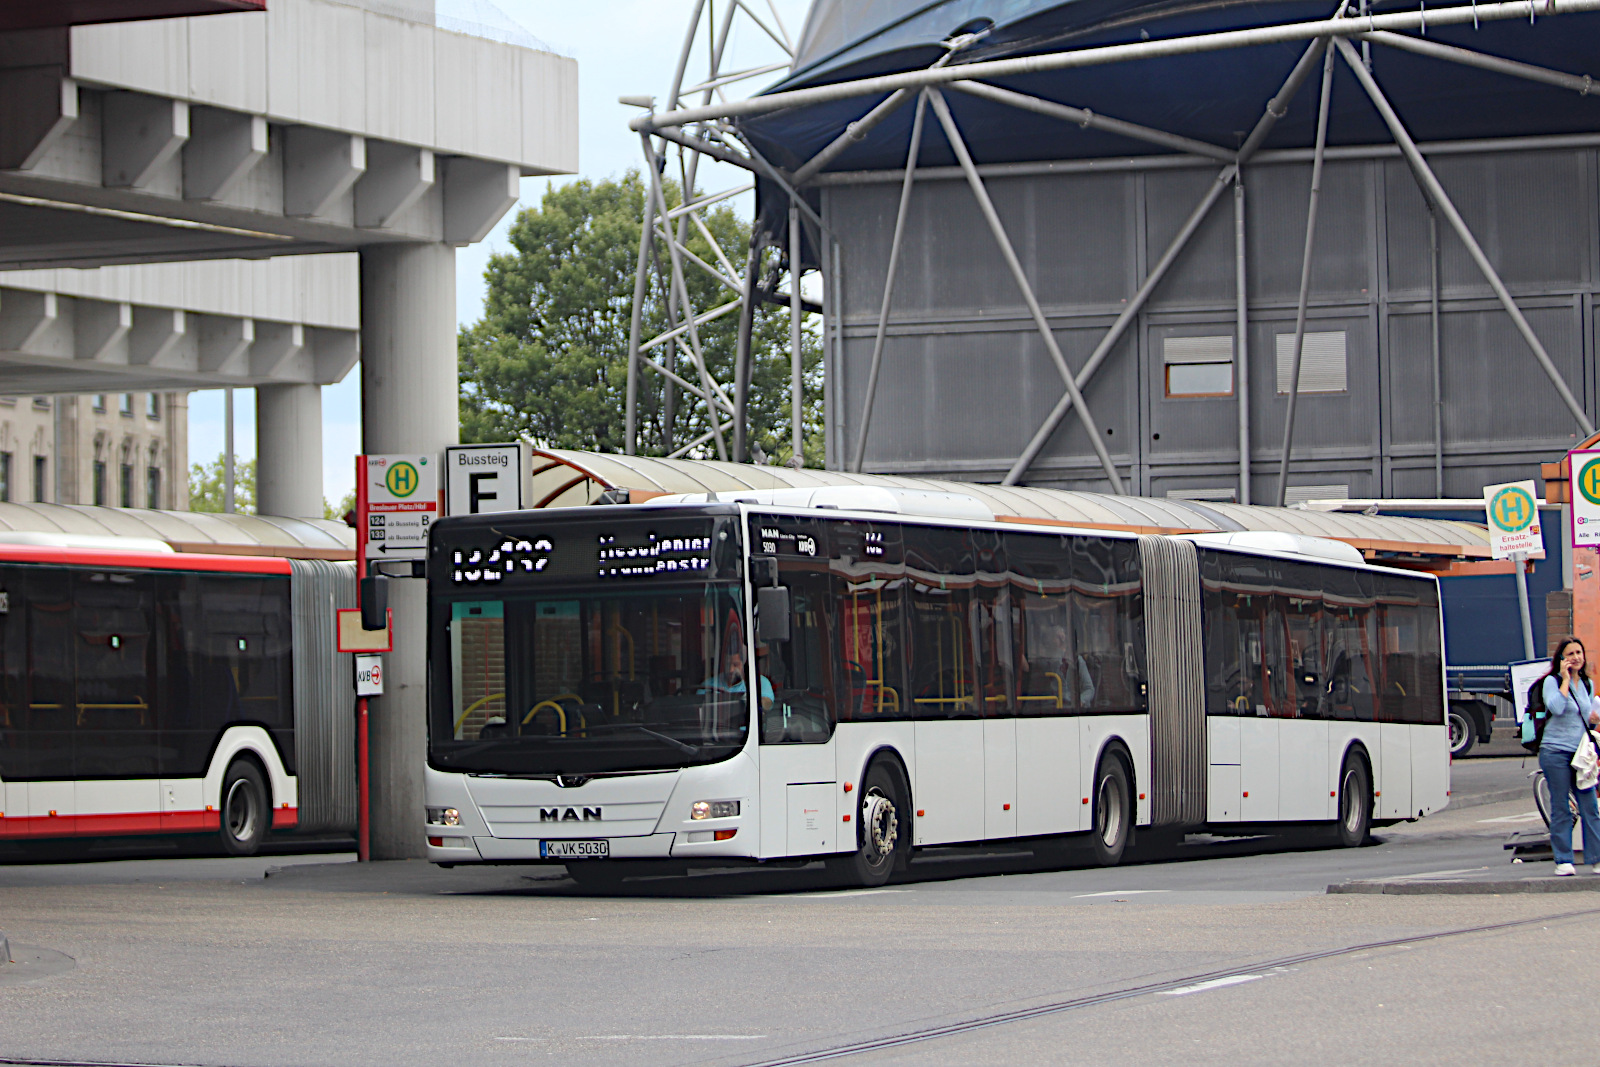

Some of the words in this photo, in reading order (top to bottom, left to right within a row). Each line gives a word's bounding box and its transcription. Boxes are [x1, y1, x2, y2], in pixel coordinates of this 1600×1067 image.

[458, 452, 508, 467] Bussteig
[395, 468, 409, 490] H
[469, 472, 498, 514] F
[1501, 496, 1524, 523] H
[371, 517, 385, 525] 124
[422, 515, 429, 526] B
[761, 528, 779, 539] MAN
[1502, 534, 1529, 542] Ersatz-
[763, 541, 776, 553] 5030
[1500, 542, 1533, 551] haltestelle
[358, 670, 371, 682] KVB
[540, 807, 602, 822] MAN
[547, 843, 554, 854] K
[562, 843, 576, 854] VK
[578, 843, 607, 854] 5030
